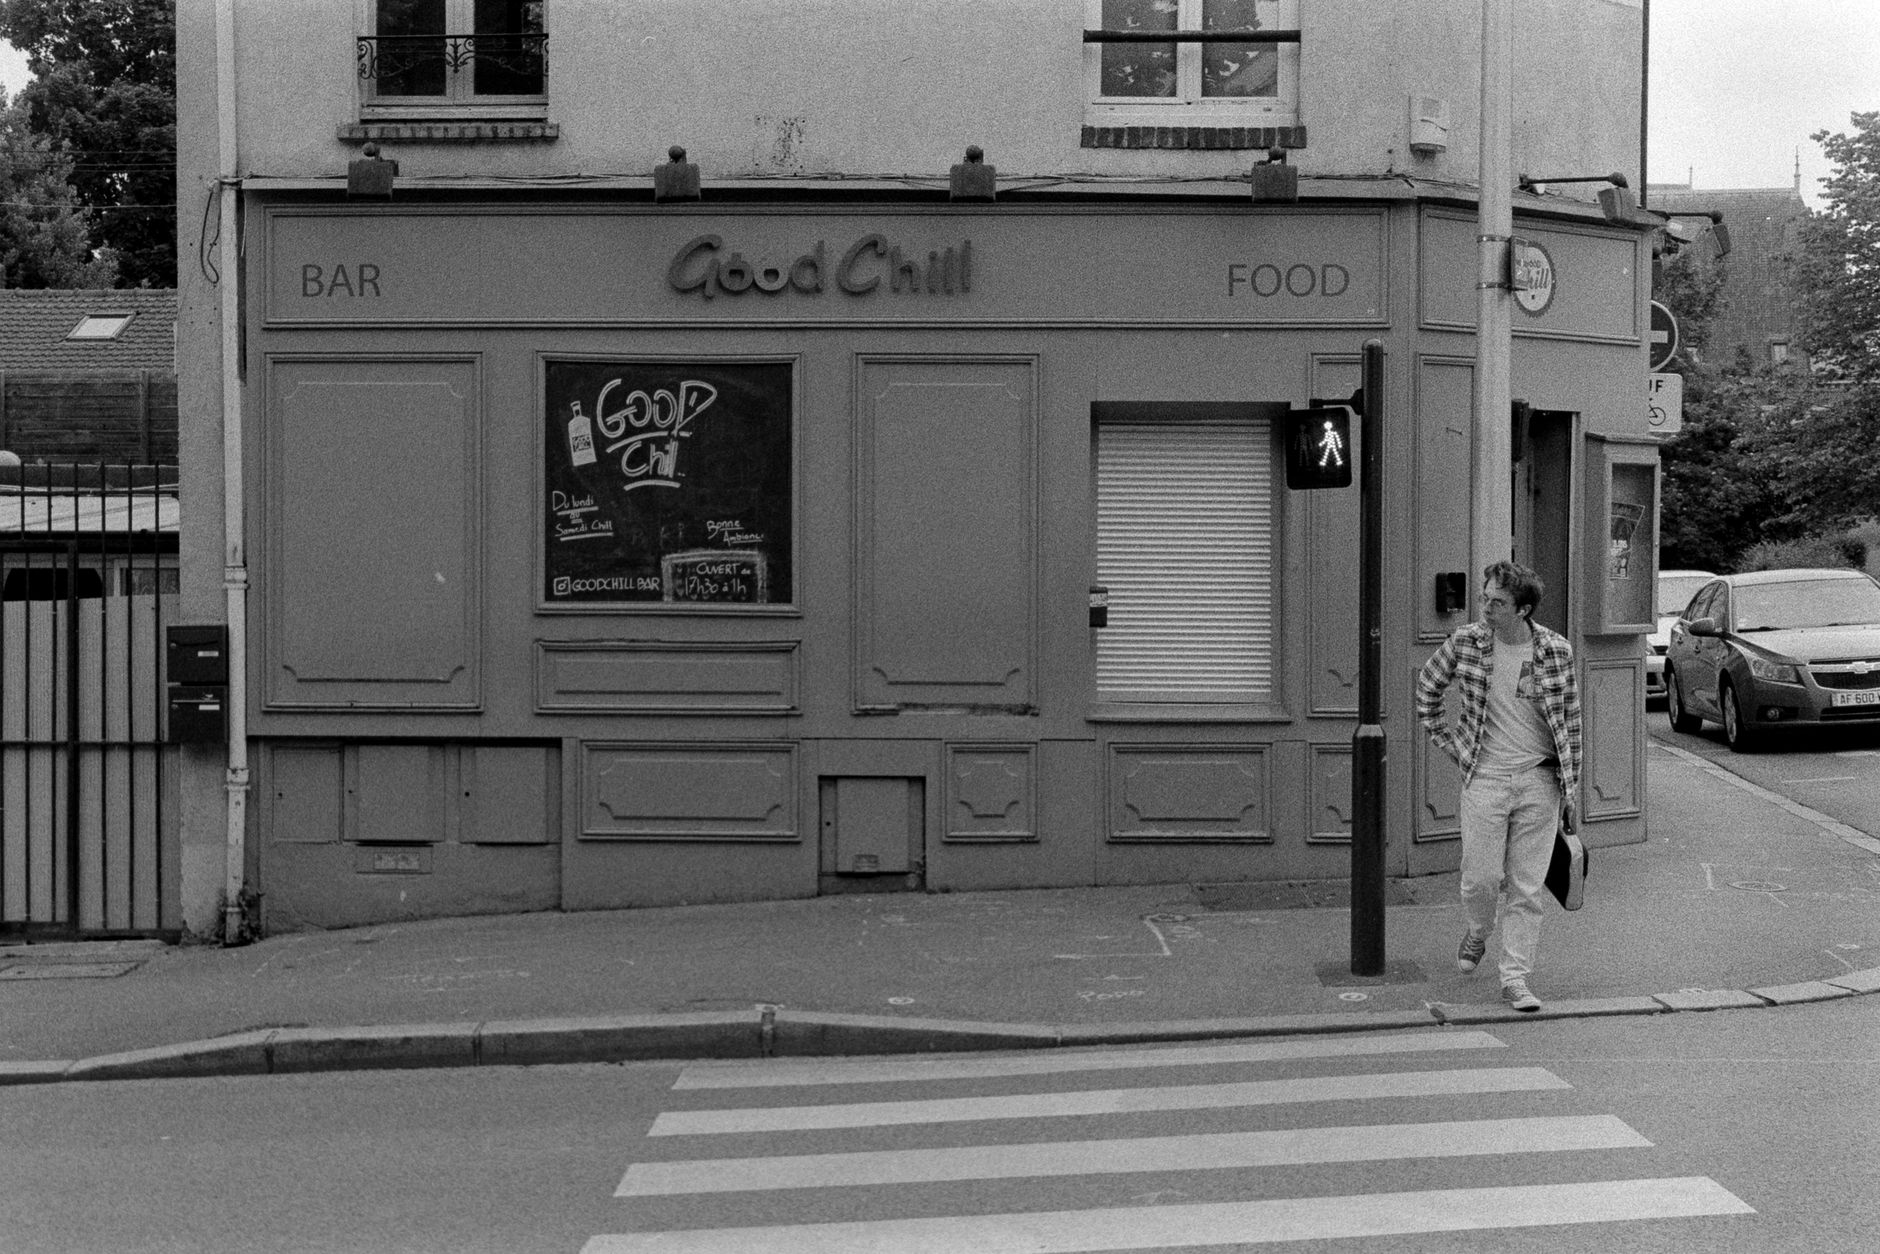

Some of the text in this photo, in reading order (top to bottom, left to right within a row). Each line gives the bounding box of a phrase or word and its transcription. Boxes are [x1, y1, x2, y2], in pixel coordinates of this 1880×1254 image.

[301, 263, 381, 298] BAR
[667, 232, 971, 301] Good Chill
[1228, 263, 1350, 298] FOOD
[552, 490, 594, 511] Du lundi
[696, 562, 741, 575] OUVERT
